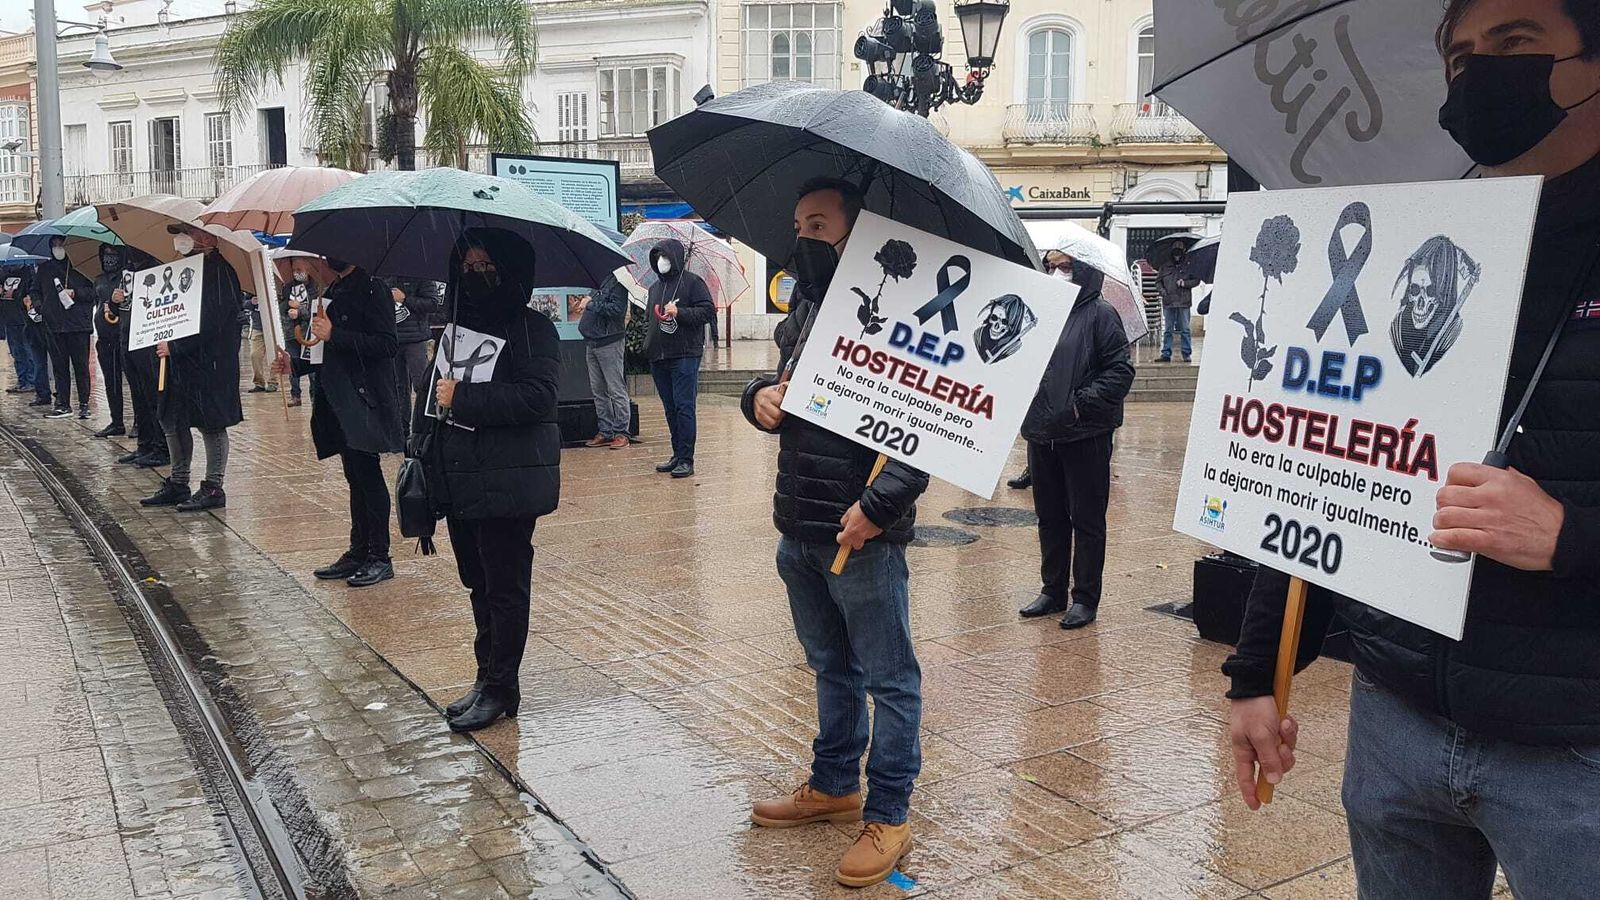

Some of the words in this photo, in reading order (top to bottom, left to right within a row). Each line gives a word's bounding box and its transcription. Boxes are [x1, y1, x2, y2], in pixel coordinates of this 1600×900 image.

[1028, 186, 1091, 200] CaixaBank
[147, 303, 184, 320] CULTURA
[153, 329, 173, 341] 2020
[887, 320, 966, 368] D.E.P
[831, 335, 996, 421] HOSTELERÍA
[836, 365, 854, 381] No
[855, 374, 876, 390] era
[877, 381, 890, 396] la
[891, 389, 943, 417] culpable
[943, 411, 973, 429] pero
[1281, 346, 1384, 401] D.E.P
[813, 373, 825, 386] la
[826, 379, 870, 406] dejaron
[872, 400, 905, 420] morir
[906, 412, 984, 454] igualmente...
[854, 414, 920, 457] 2020
[1219, 393, 1439, 482] HOSTELERÍA
[1203, 462, 1217, 481] la
[1219, 467, 1273, 499] dejaron
[1276, 487, 1318, 511] morir
[1228, 440, 1248, 461] No
[1250, 449, 1274, 469] era
[1278, 453, 1293, 474] la
[1296, 461, 1366, 494] culpable
[1370, 482, 1412, 507] pero
[1199, 515, 1225, 530] ASIHTUR
[1259, 512, 1344, 575] 2020
